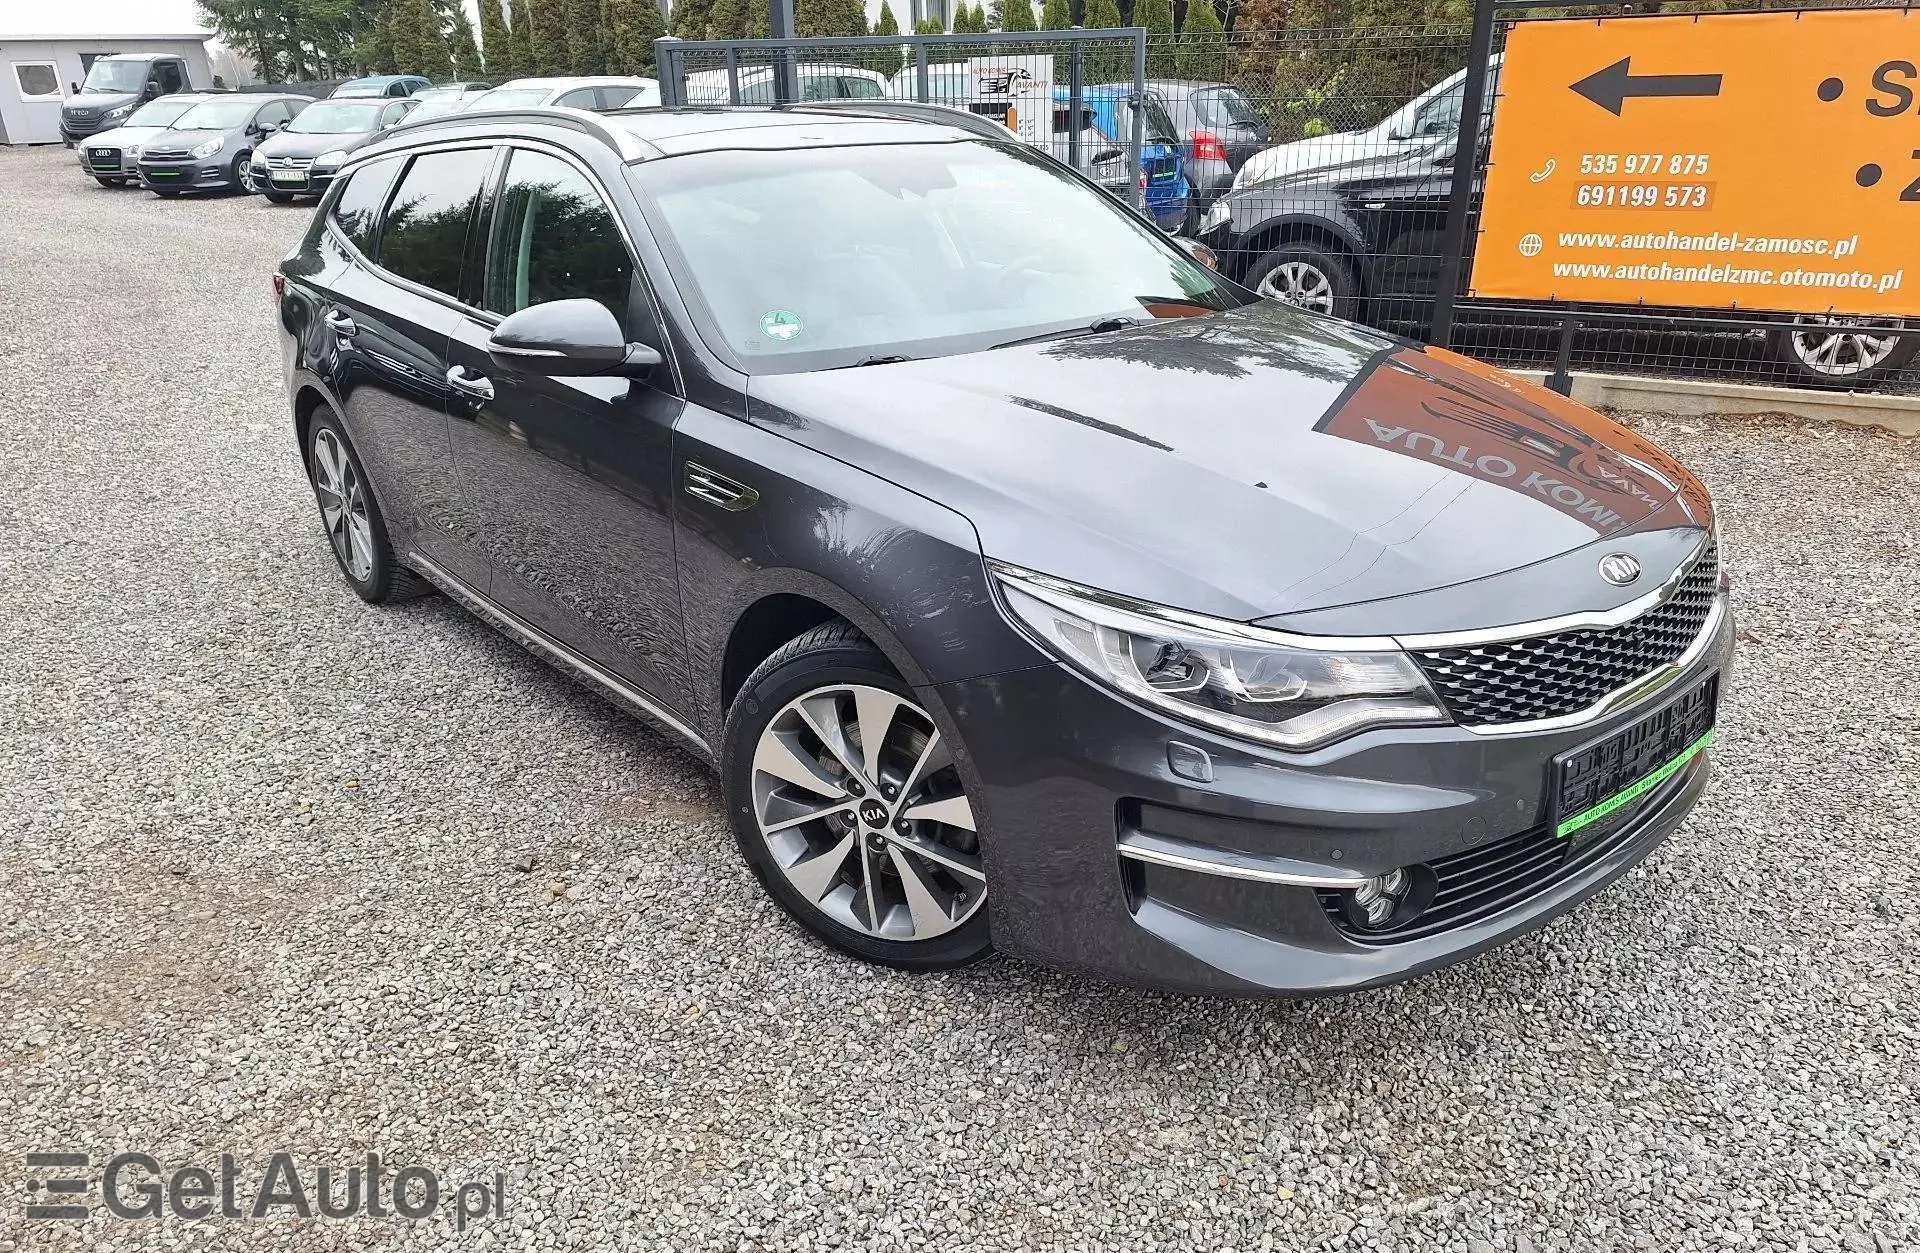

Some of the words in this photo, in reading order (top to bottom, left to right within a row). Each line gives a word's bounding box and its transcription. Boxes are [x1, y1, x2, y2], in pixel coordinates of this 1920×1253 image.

[1865, 60, 1920, 117] S
[1580, 154, 1618, 175] 535
[1623, 154, 1663, 175] 977
[1668, 154, 1710, 175] 875
[1664, 185, 1708, 208] 573
[1558, 230, 1859, 257] www.autohandel-zamosc.pl
[1552, 261, 1904, 293] www.autohandelzmc.otomoto.pl
[774, 312, 787, 325] 4
[1603, 555, 1640, 581] KIA
[862, 808, 887, 821] KIA
[1584, 808, 1600, 822] AUTO
